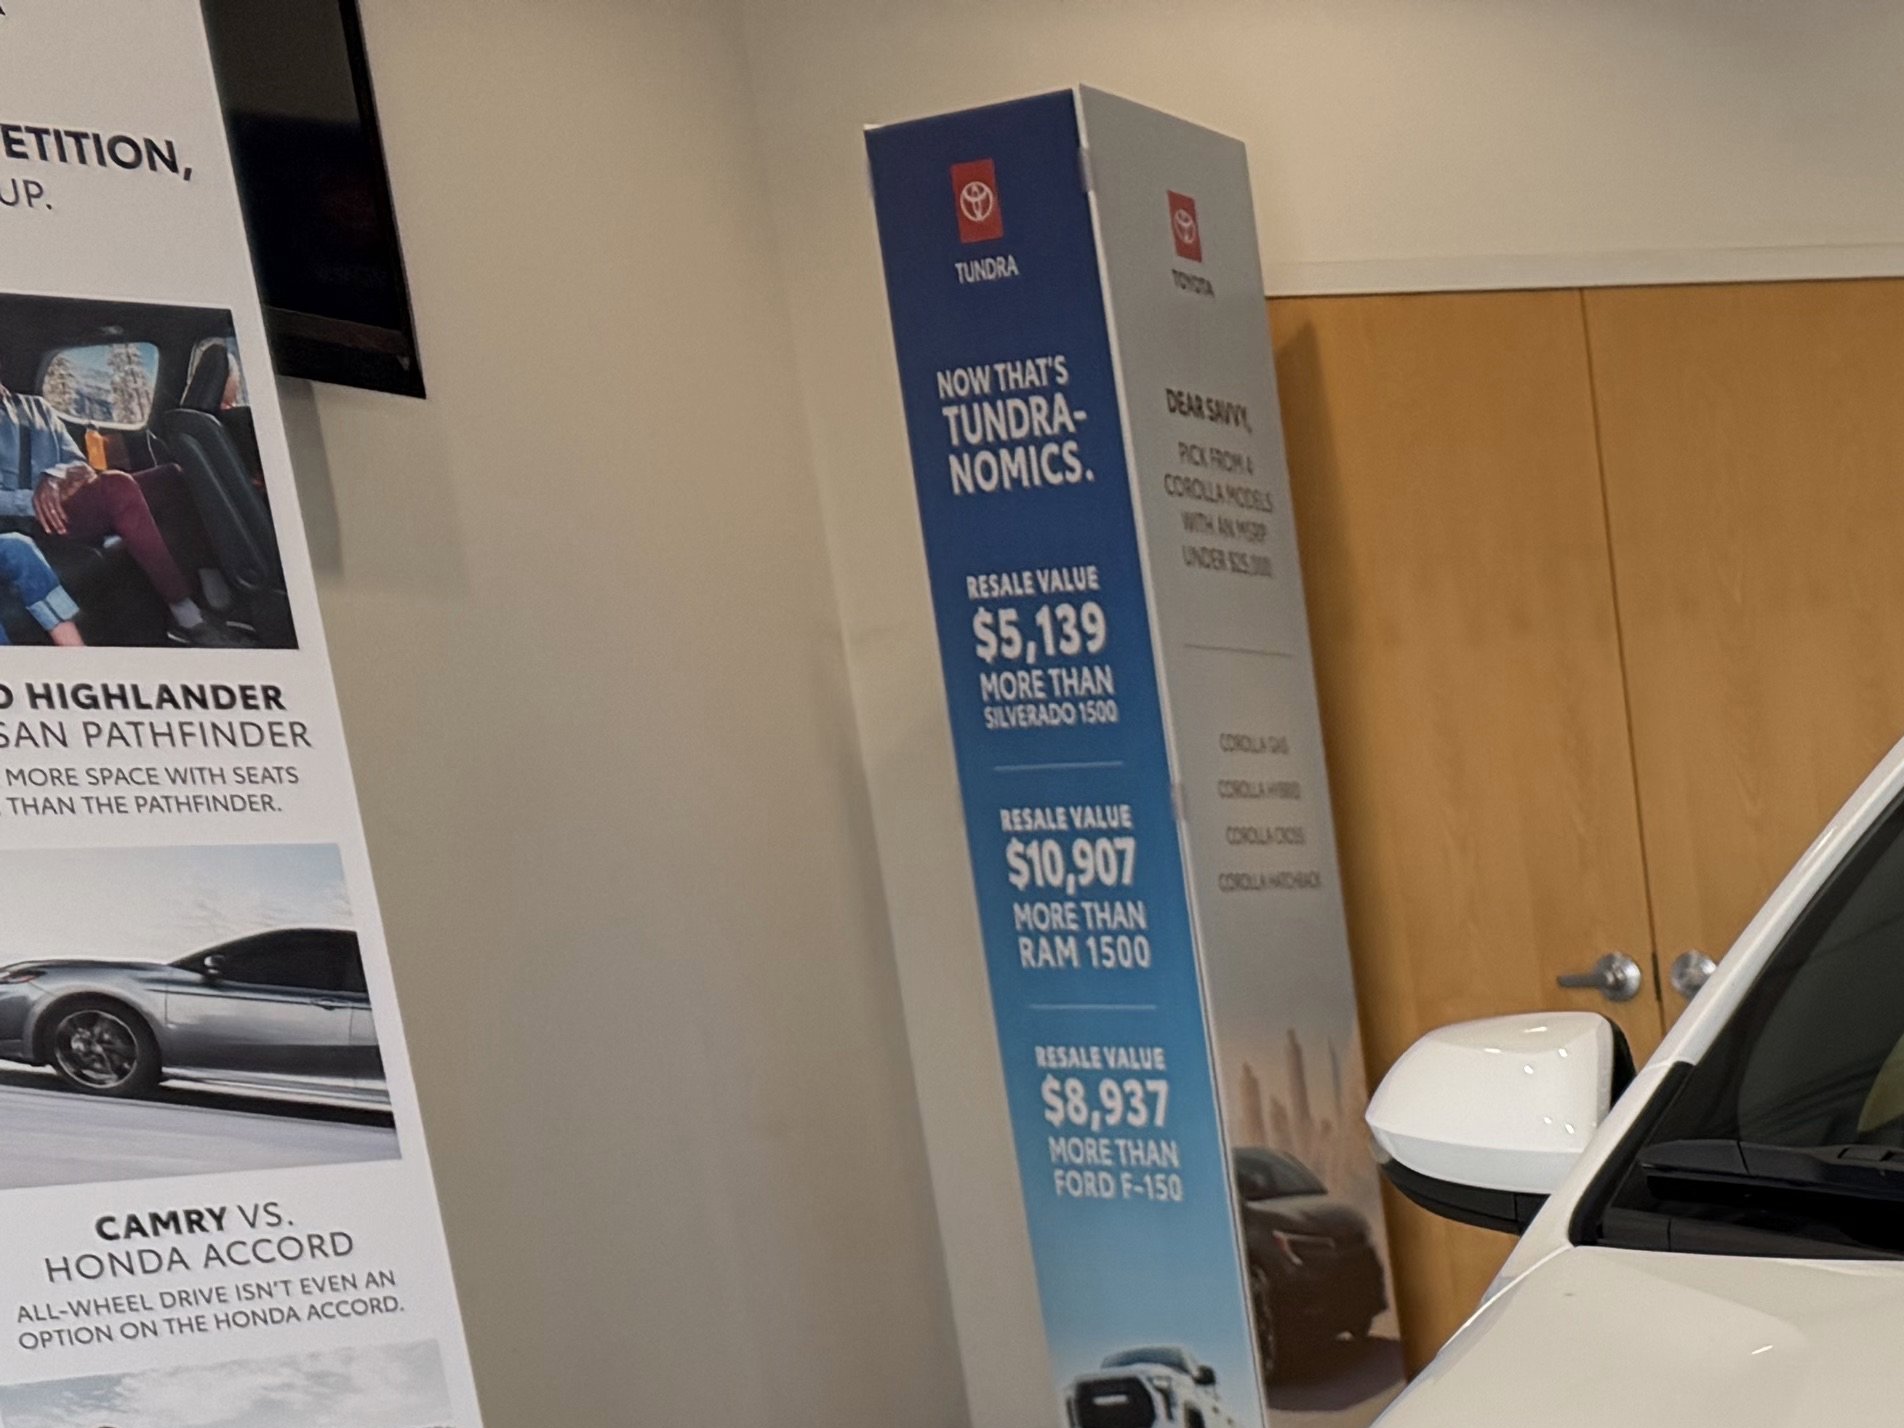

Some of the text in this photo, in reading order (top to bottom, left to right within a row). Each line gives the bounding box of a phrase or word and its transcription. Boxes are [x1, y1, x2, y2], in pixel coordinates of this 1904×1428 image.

[955, 255, 1019, 284] TUNDRA
[937, 355, 1069, 399] NOW THAT'S
[942, 392, 1087, 446] TUNDRA-
[1166, 388, 1205, 419] DEAR
[948, 440, 1095, 495] NOMICS.
[1164, 473, 1223, 503] COROLLA
[966, 565, 1100, 599] RESALE VALUE
[972, 601, 1107, 664] $5,139
[25, 682, 288, 711] HIGHLANDER
[979, 665, 1115, 701] MORE THAN
[984, 699, 1119, 729] SILVERADO 1500
[82, 721, 312, 748] PATHFINDER
[5, 766, 299, 787] MORE SPACE WITH SEATS
[6, 794, 283, 815] THAN THE PATHFINDER.
[1000, 804, 1134, 831] RESALE VALUE
[1006, 836, 1136, 896] $10,907
[1012, 900, 1148, 932] MORE THAN
[1018, 935, 1151, 968] RAM 1500
[1035, 1045, 1167, 1070] RESALE VALUE
[1041, 1074, 1169, 1132] $8,937
[1048, 1136, 1180, 1168] MORE THAN
[1054, 1169, 1183, 1202] FORD F-150
[95, 1202, 294, 1241] CAMRY VS.
[45, 1231, 354, 1283] HONDA ACCORD
[17, 1270, 397, 1323] ALL-WHEEL DRIVE ISN'T EVEN AN
[18, 1296, 404, 1350] OPTION ON THE HONDA ACCORD.
